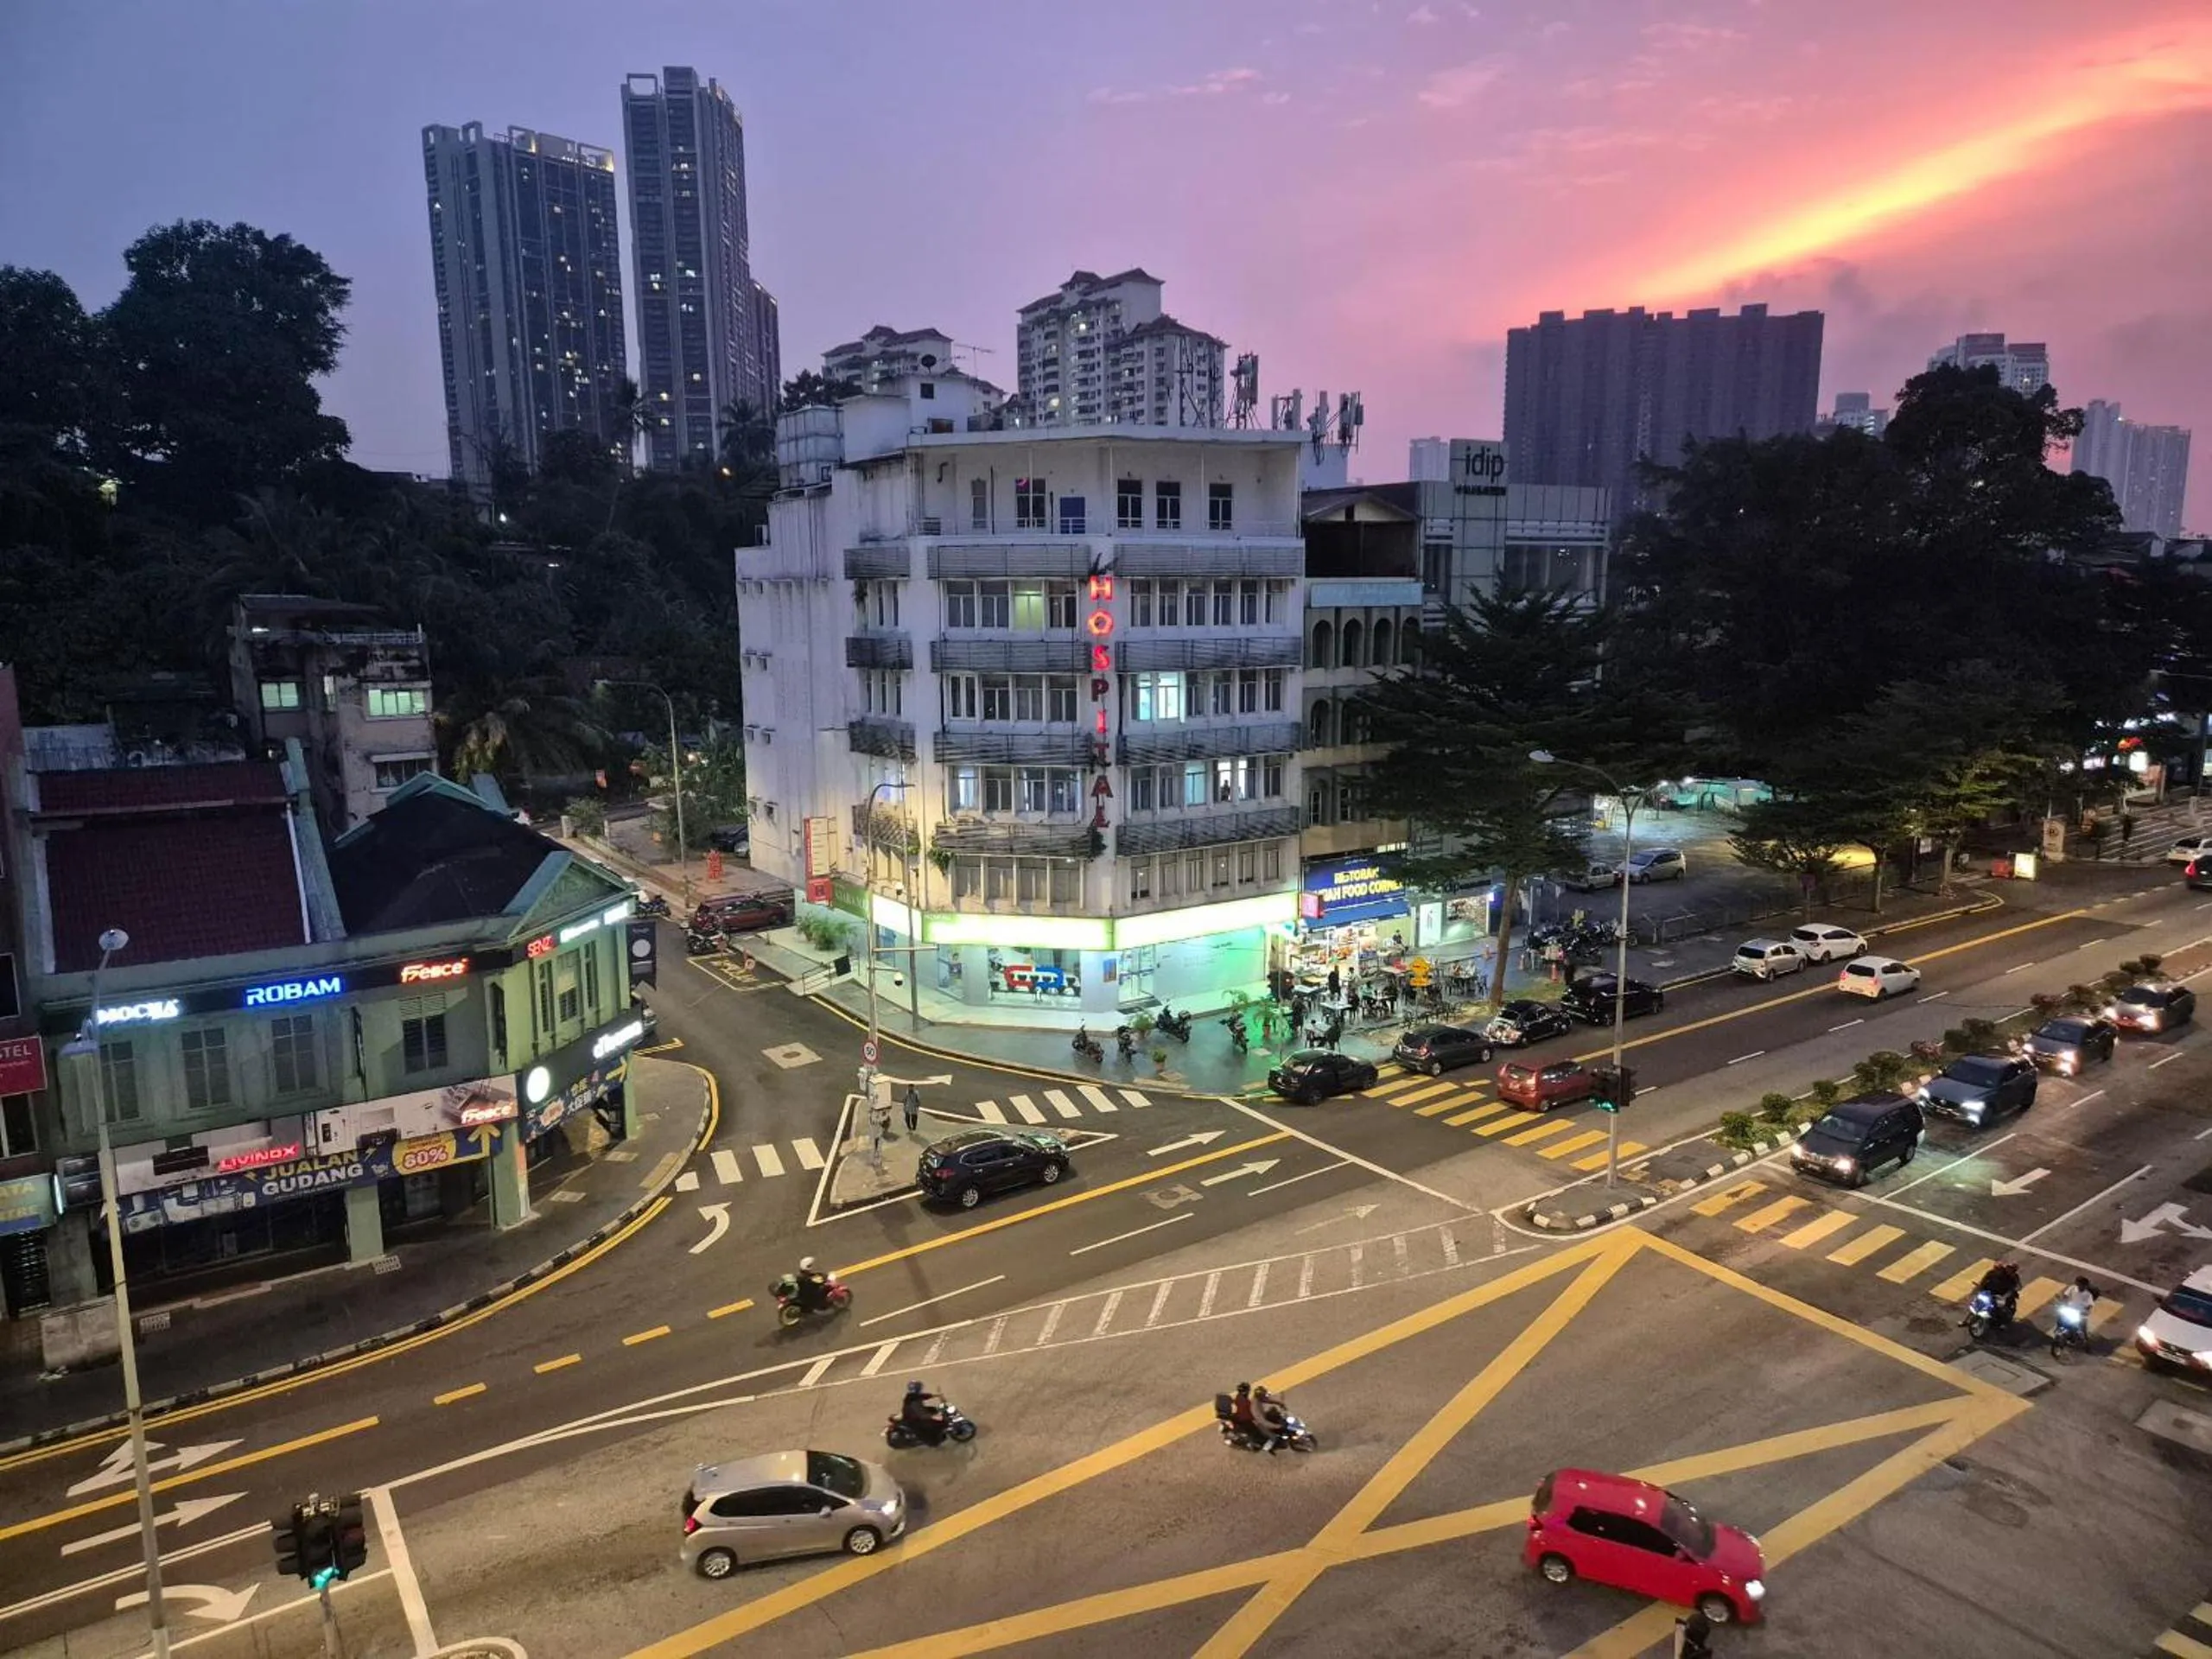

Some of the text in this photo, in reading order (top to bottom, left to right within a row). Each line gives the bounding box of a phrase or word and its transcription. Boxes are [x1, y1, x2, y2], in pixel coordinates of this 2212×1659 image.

[1465, 445, 1504, 483] idip
[1087, 575, 1114, 828] HOSPITAL
[1342, 882, 1368, 899] FOOD
[247, 977, 340, 1006] ROBAM
[0, 1044, 32, 1058] TEL
[219, 1145, 297, 1170] LIVINOX
[264, 1150, 359, 1180] JUALAN
[262, 1163, 364, 1196] GUDANG
